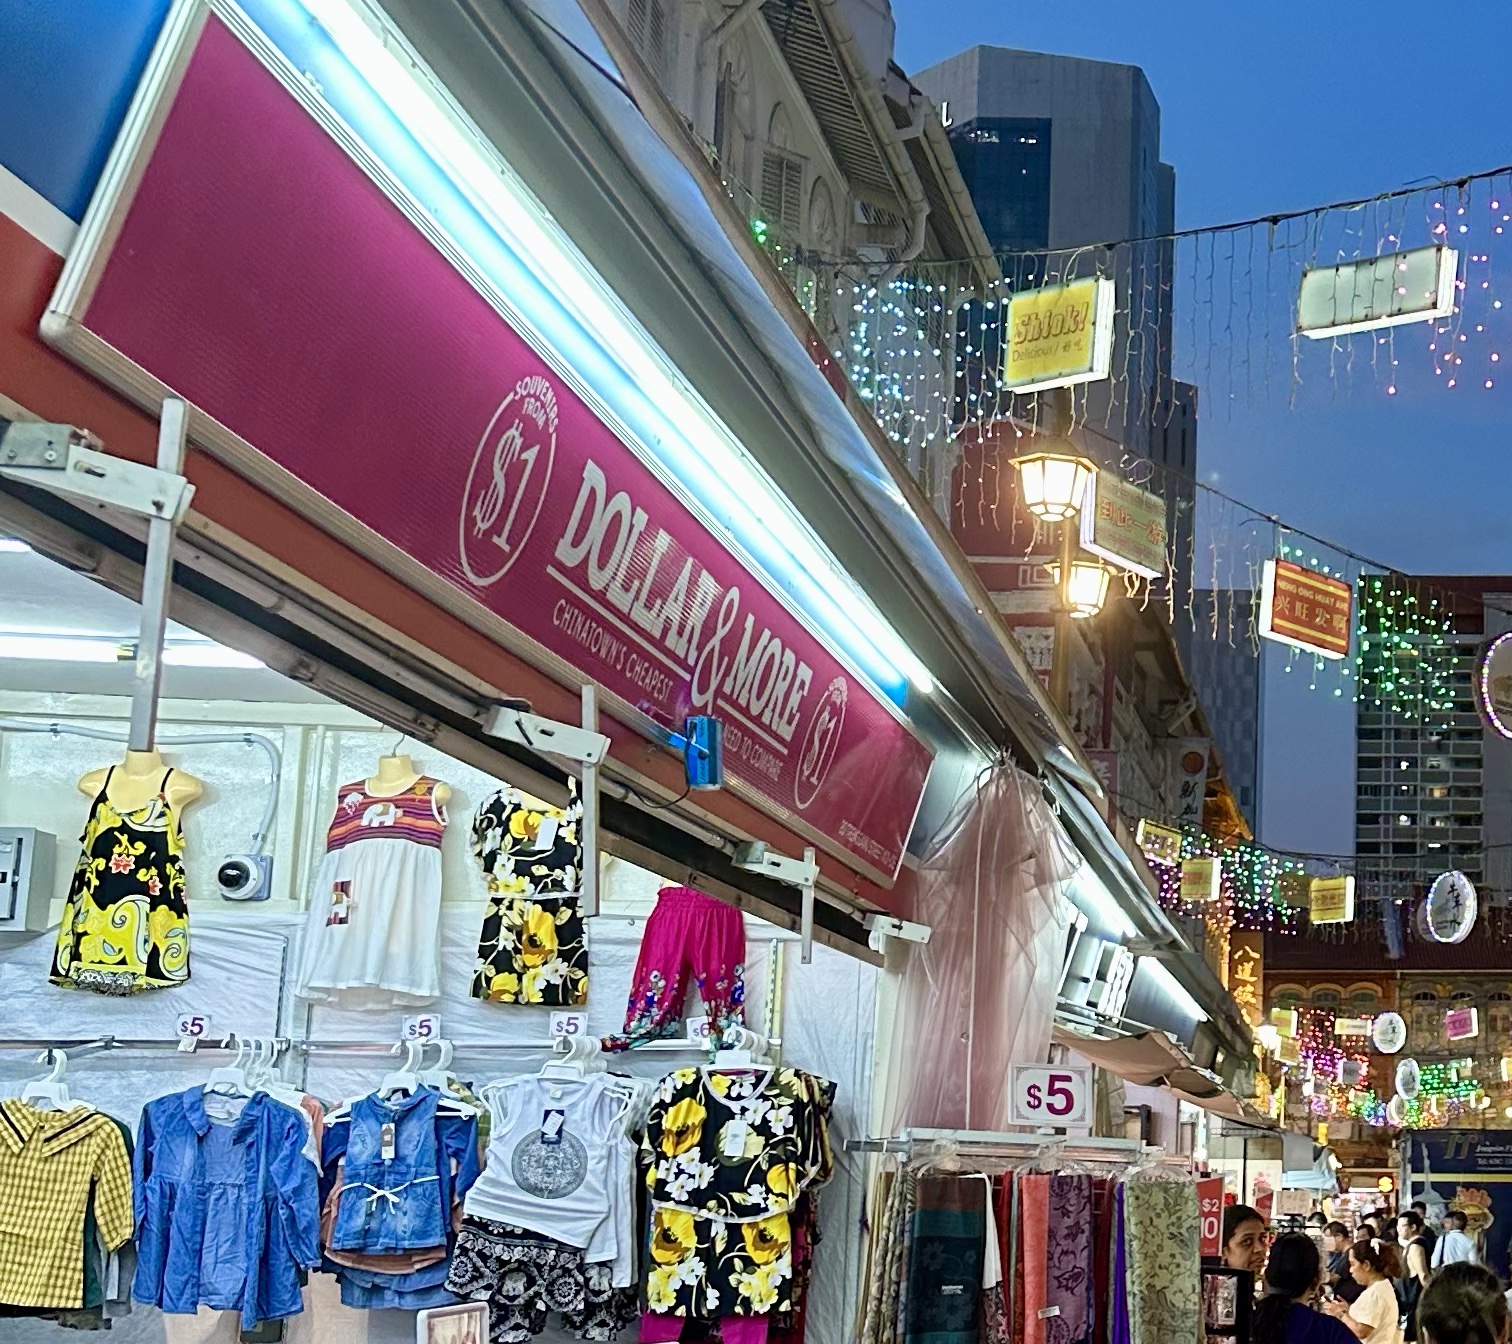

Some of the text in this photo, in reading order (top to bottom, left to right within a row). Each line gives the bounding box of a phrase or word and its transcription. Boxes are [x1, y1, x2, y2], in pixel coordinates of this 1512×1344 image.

[1014, 301, 1089, 345] Shiok!
[515, 375, 559, 434] SOUVENIRS
[522, 397, 547, 431] FROM
[473, 418, 541, 553] $1
[555, 458, 813, 742] DOLLAR & MORE
[1298, 586, 1314, 599] ONG
[552, 598, 675, 702] CHINATOWN'S CHEAPEST
[181, 1016, 205, 1036] $5
[408, 1018, 432, 1038] $5
[555, 1016, 579, 1035] $5
[1026, 1074, 1075, 1116] $5
[1202, 1198, 1219, 1212] $2
